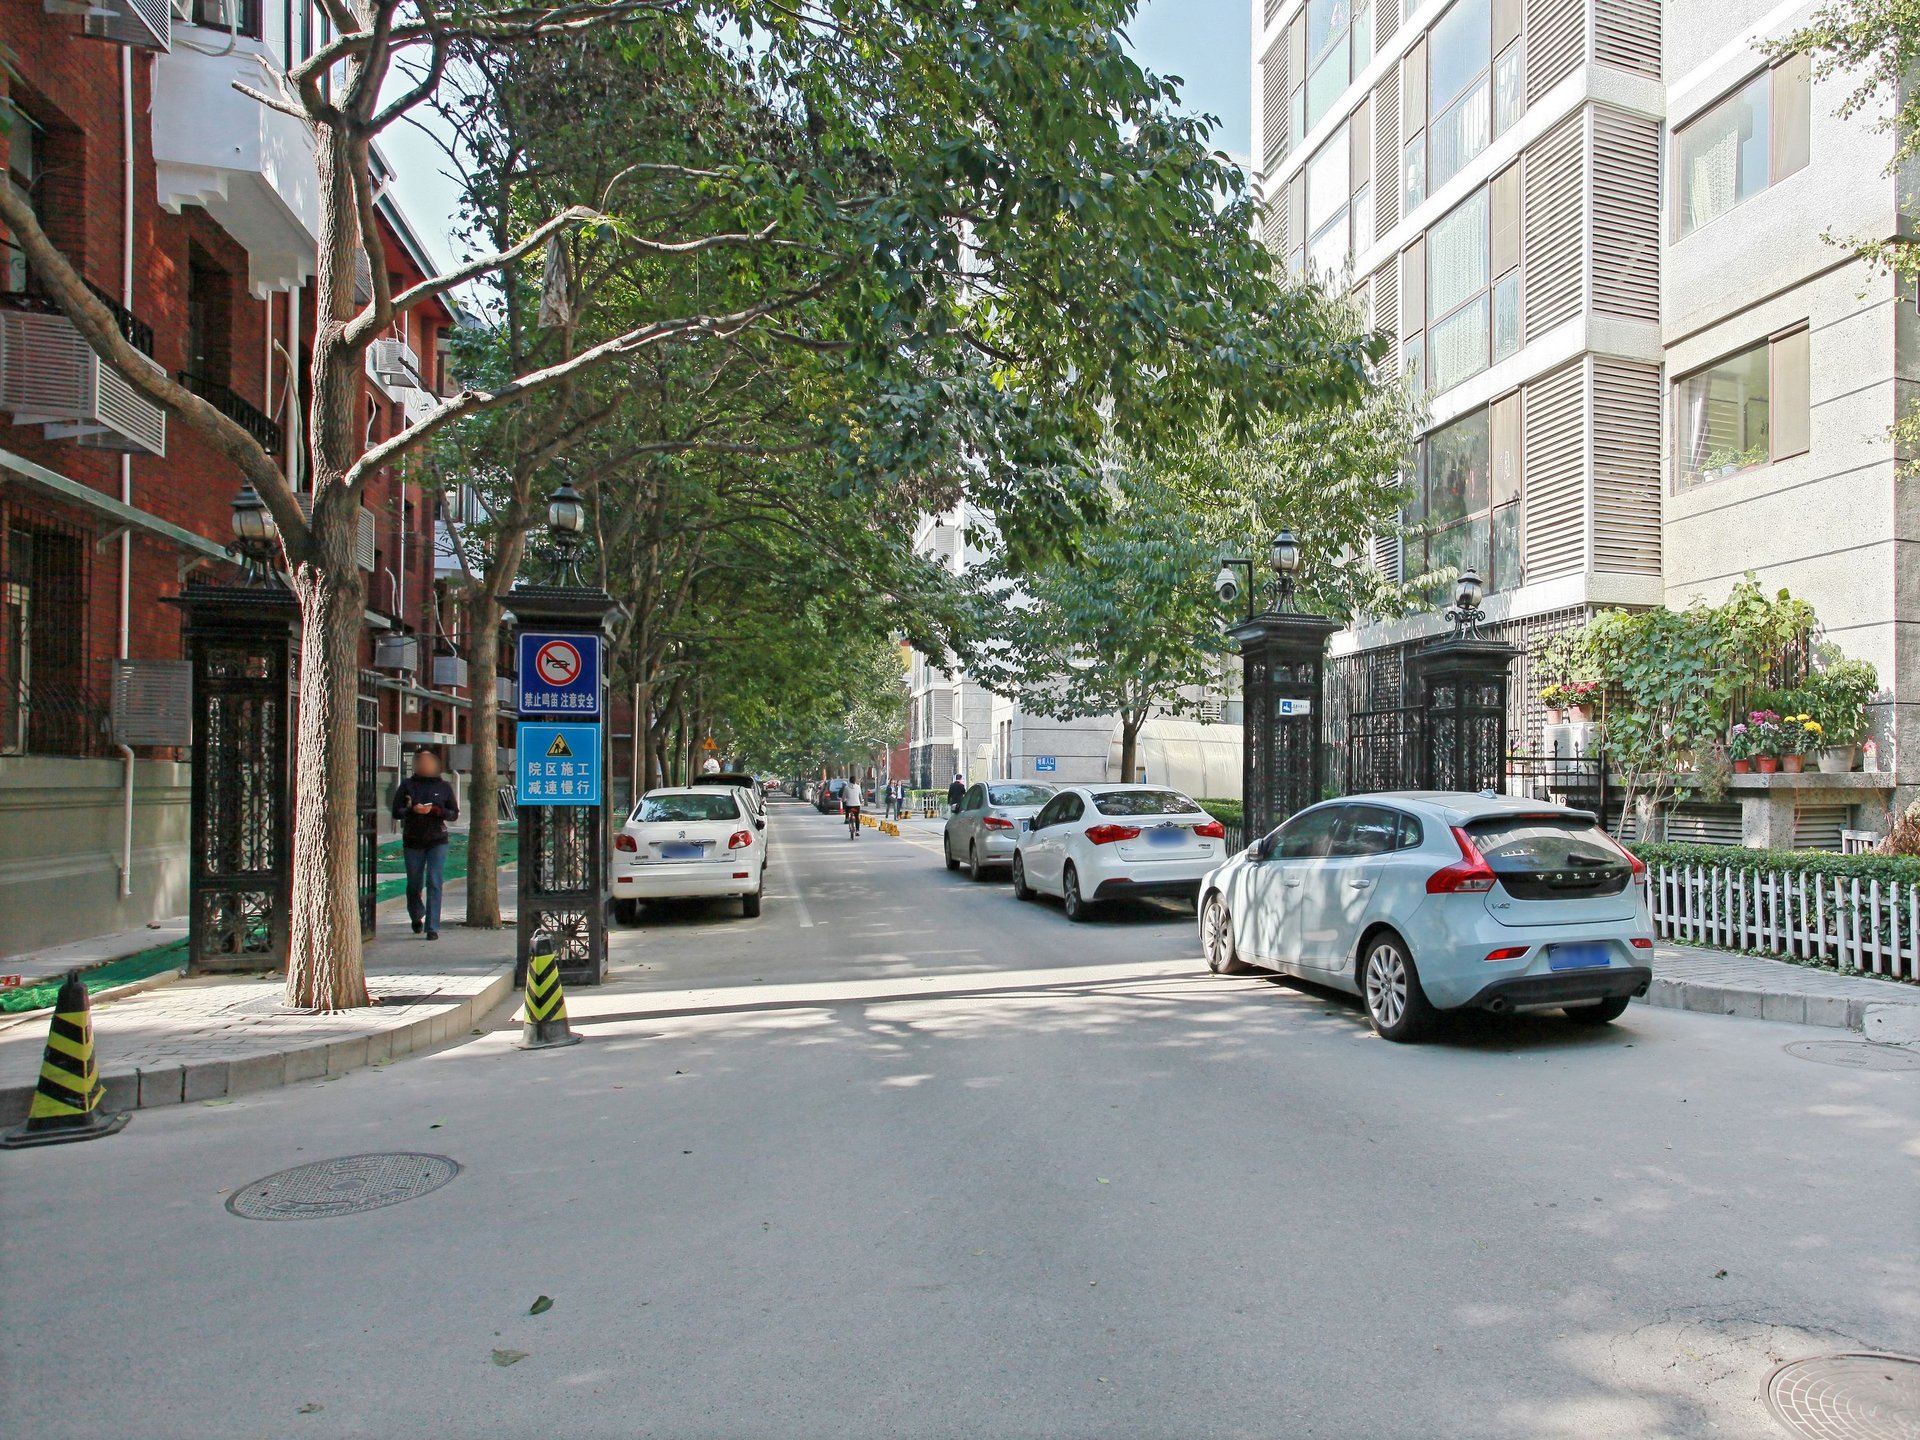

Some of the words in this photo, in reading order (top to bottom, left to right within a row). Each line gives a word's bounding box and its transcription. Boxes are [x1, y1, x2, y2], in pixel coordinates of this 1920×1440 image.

[524, 692, 559, 708] 禁止鸣笛
[560, 692, 594, 708] 注意安全
[528, 762, 590, 776] 院区施工
[528, 780, 590, 795] 减速慢行
[1536, 872, 1611, 880] VOLVO
